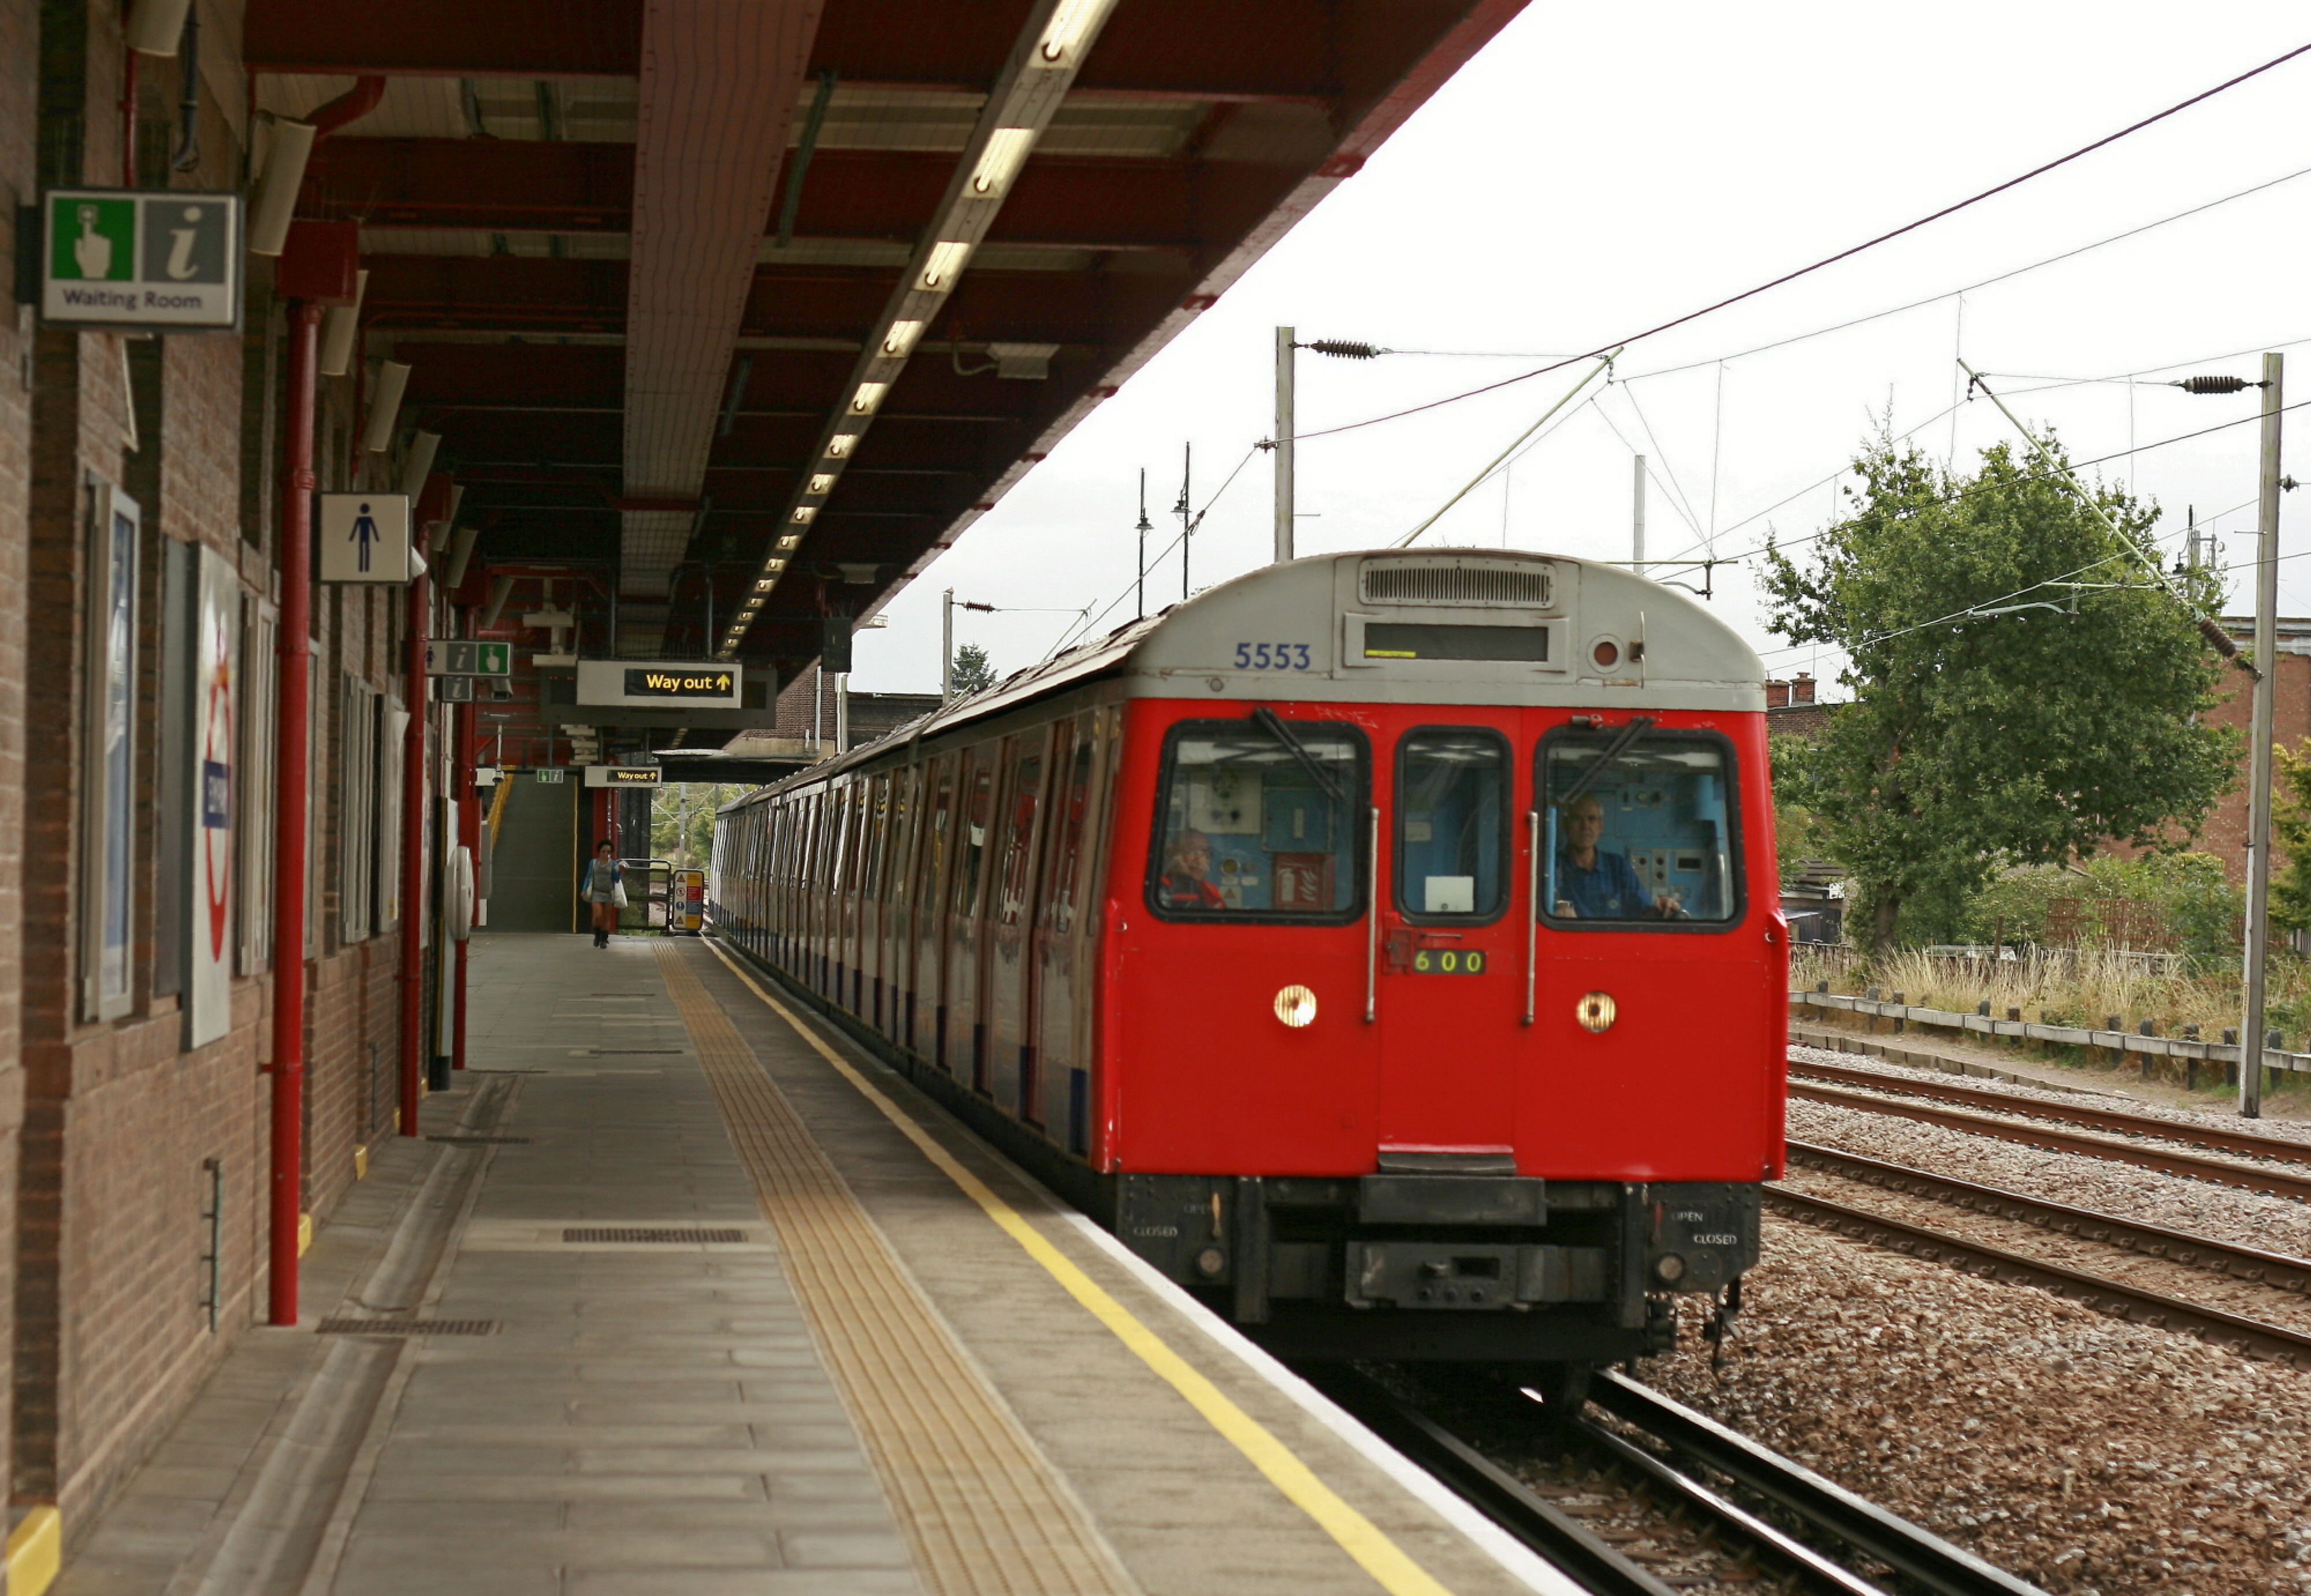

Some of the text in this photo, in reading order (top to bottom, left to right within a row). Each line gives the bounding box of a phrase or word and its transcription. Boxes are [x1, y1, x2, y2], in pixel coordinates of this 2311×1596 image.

[62, 289, 202, 311] Waiting Room
[1234, 642, 1310, 670] 5553
[646, 674, 713, 692] Way out
[616, 771, 634, 780] Way
[1415, 950, 1481, 972] 600
[1671, 1211, 1703, 1222] OPEN
[1133, 1225, 1179, 1237] CLOSED
[1693, 1233, 1738, 1245] CLOSED
